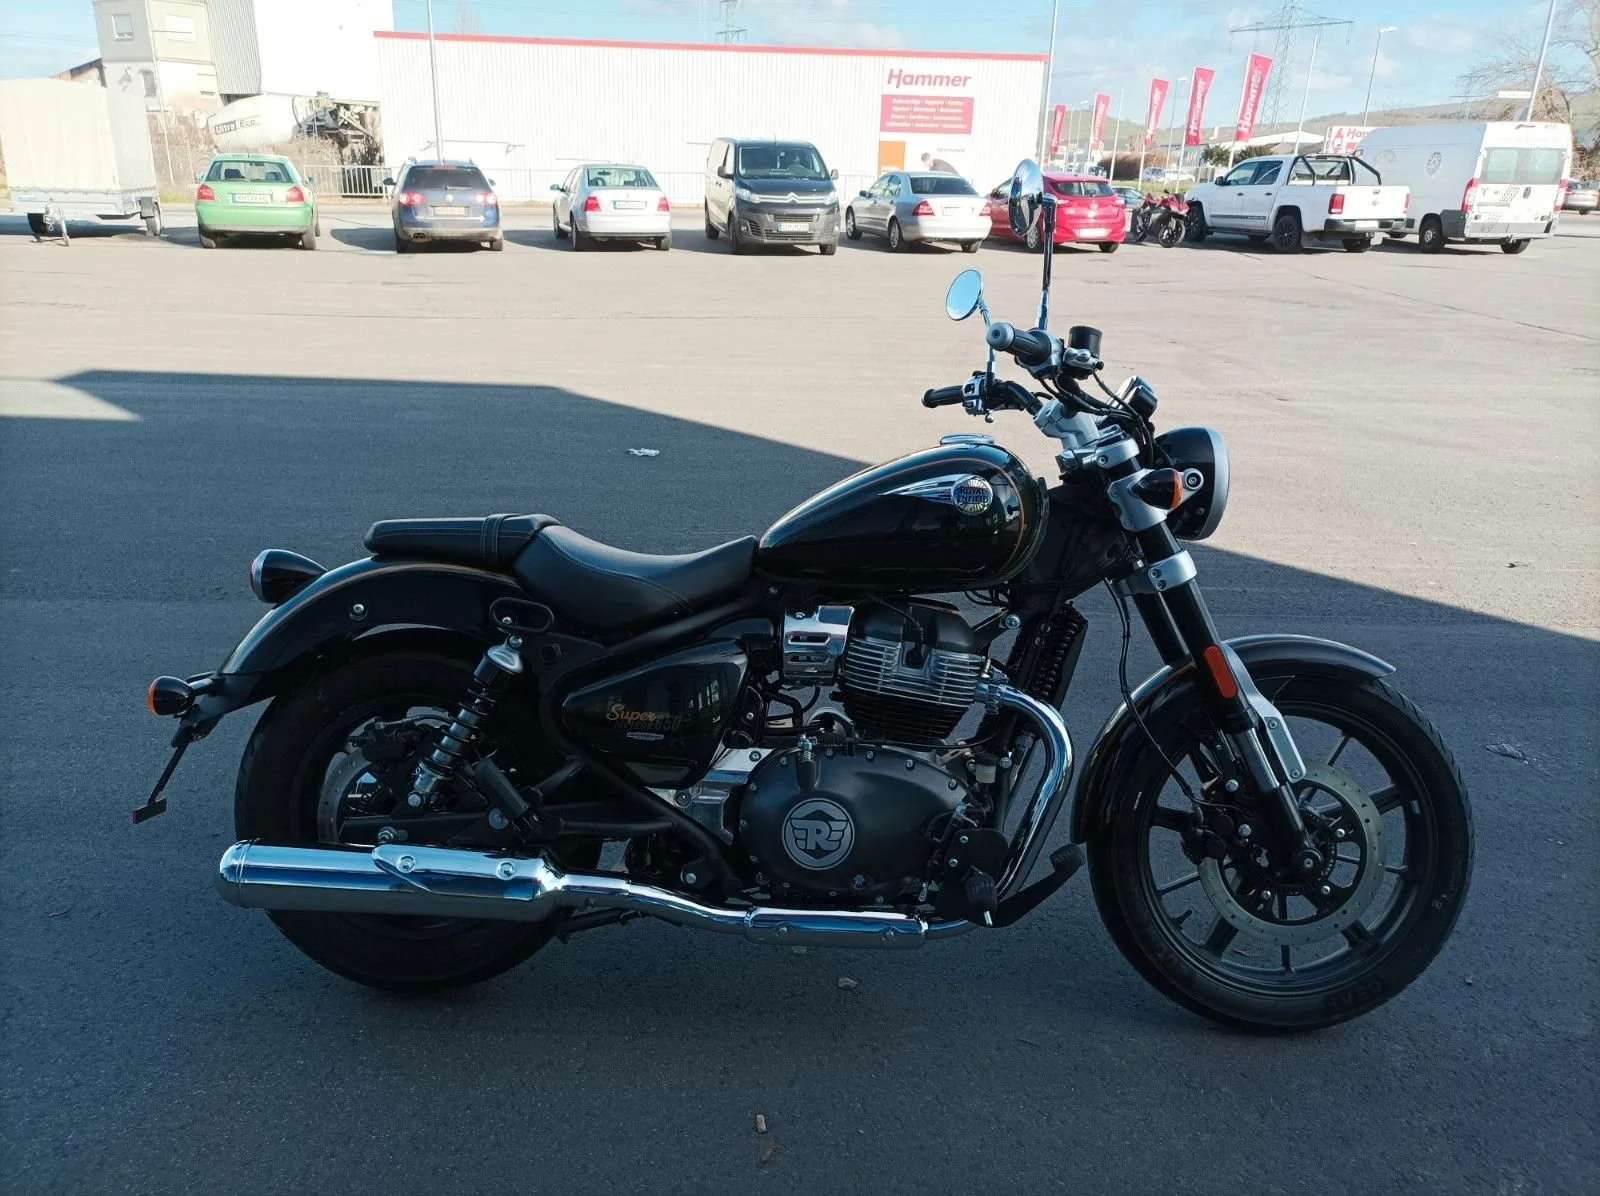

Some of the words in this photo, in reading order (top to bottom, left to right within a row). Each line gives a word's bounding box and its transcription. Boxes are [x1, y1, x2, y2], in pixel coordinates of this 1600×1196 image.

[887, 68, 972, 89] Hammer
[1189, 78, 1207, 137] Hammer
[1237, 66, 1263, 132] Hammer
[215, 122, 236, 135] Ultra
[239, 119, 256, 128] Eco
[957, 494, 989, 503] ENFIELD
[959, 486, 986, 495] ROYAL
[605, 703, 657, 724] Super
